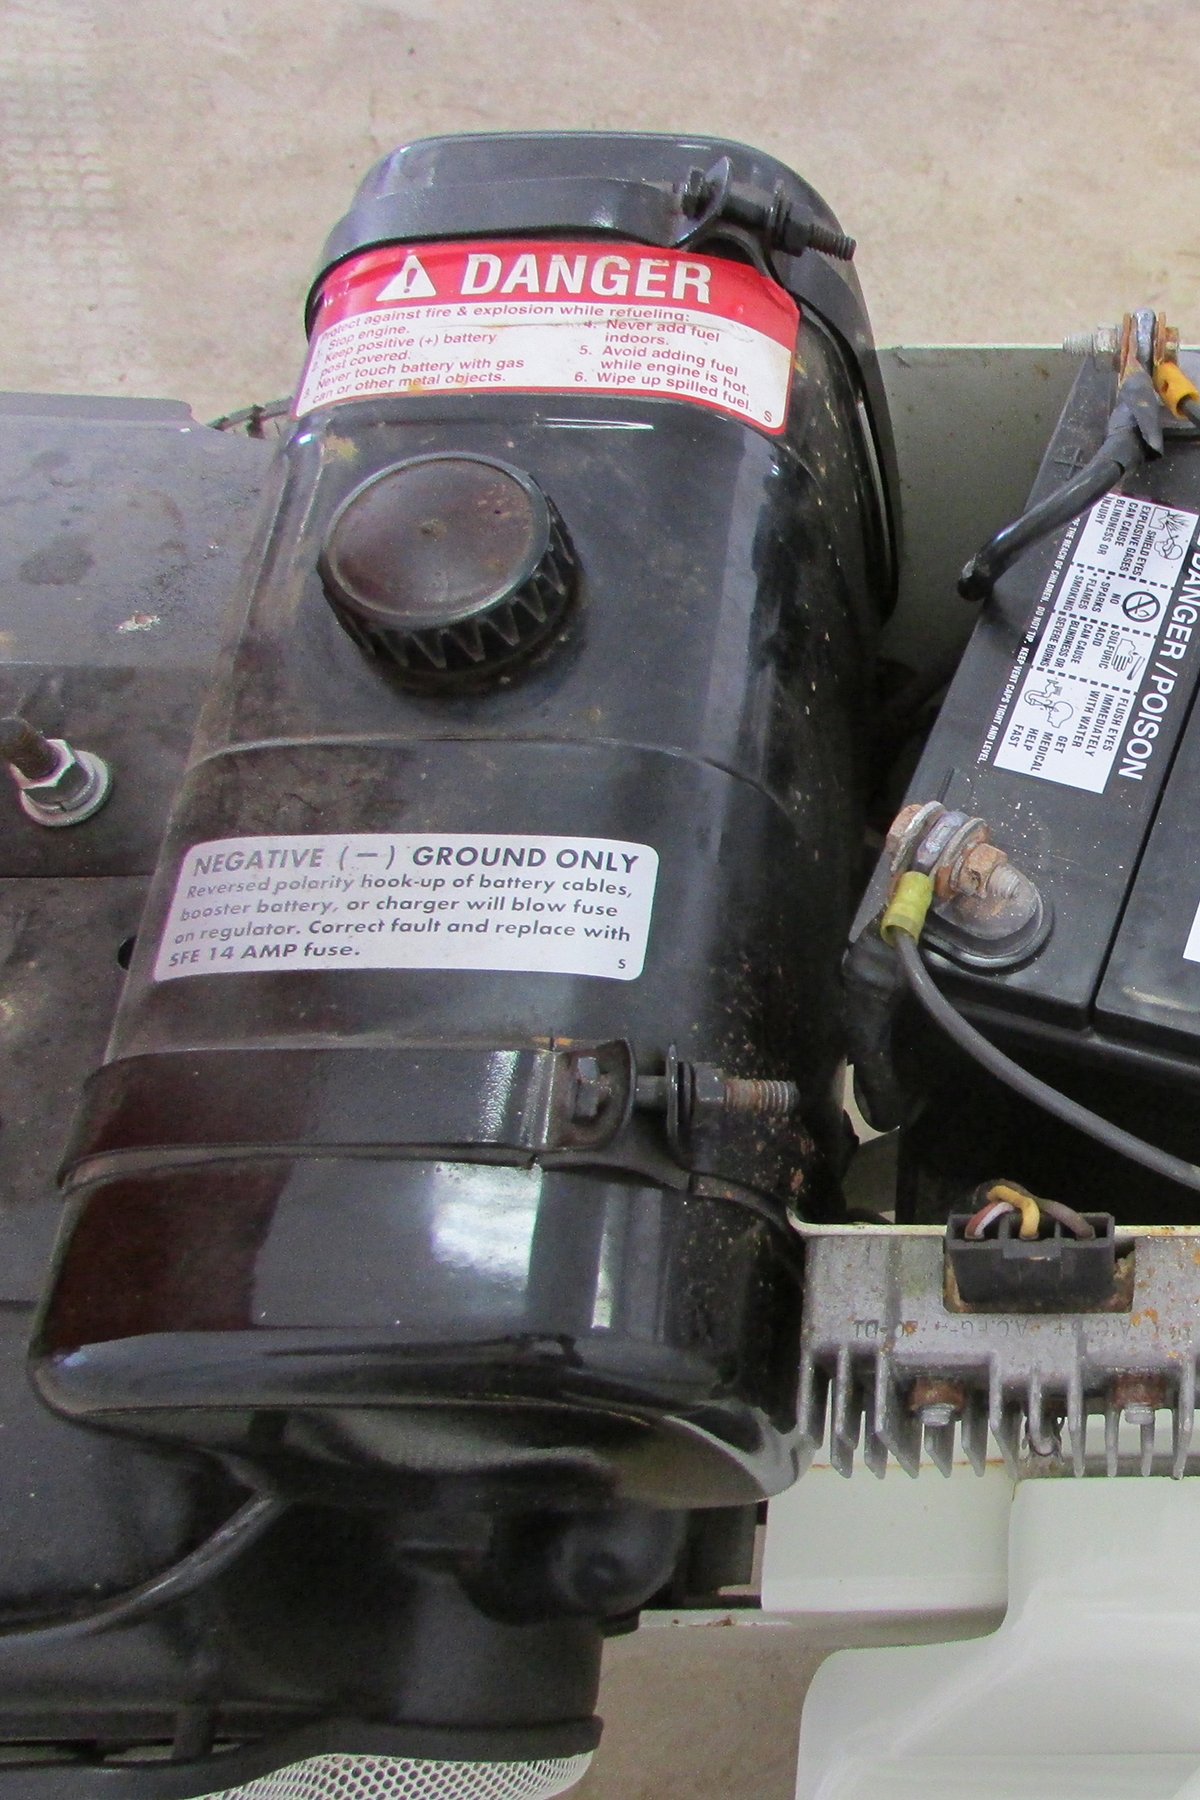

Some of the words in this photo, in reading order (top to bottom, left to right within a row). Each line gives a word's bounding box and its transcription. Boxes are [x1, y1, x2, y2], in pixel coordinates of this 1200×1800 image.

[460, 254, 712, 304] DANGER
[365, 310, 420, 330] against
[426, 307, 451, 318] fire
[457, 306, 467, 316] &
[473, 304, 553, 317] explosion
[560, 304, 604, 316] while
[609, 308, 690, 322] refueling:
[358, 325, 409, 340] engine.
[605, 333, 669, 346] indoors.
[606, 319, 652, 331] Never
[656, 323, 686, 334] add
[691, 325, 720, 342] fuel
[356, 337, 414, 354] positive
[444, 333, 496, 345] battery
[350, 351, 411, 366] covered.
[579, 345, 592, 356] 5.
[602, 346, 647, 357] Avoid
[651, 349, 706, 368] adding
[711, 359, 738, 377] fuel
[316, 373, 349, 392] Never
[355, 364, 395, 379] touch
[401, 360, 454, 374] battery
[459, 359, 491, 370] with
[496, 359, 525, 371] gas
[337, 384, 350, 396] or
[354, 376, 394, 391] other
[399, 372, 440, 386] metal
[445, 372, 506, 385] objects.
[601, 360, 642, 371] while
[647, 364, 700, 379] engine
[705, 371, 718, 383] is
[723, 376, 750, 396] hot.
[574, 372, 587, 382] 6.
[597, 372, 636, 386] Wipe
[641, 376, 661, 388] up
[666, 378, 718, 397] spilled
[722, 391, 752, 412] fuel.
[764, 410, 773, 423] S
[1093, 495, 1113, 525] INJURY
[1101, 498, 1126, 542] BLINDNESS
[1124, 501, 1138, 519] CAN
[1113, 520, 1132, 547] CAUSE
[1128, 504, 1151, 546] EXPLOSIVE
[1096, 543, 1109, 555] OR
[1139, 529, 1156, 556] SHIELD
[1118, 546, 1136, 572] GASES
[1131, 556, 1146, 576] EYES
[1062, 574, 1084, 611] SMOKING
[1077, 578, 1097, 610] FLAMES
[1091, 581, 1110, 612] SPARKS
[1109, 593, 1121, 605] NO
[1048, 616, 1066, 643] SEVERE
[1057, 619, 1079, 657] BLINDNESS
[1079, 622, 1093, 639] CAN
[1091, 626, 1107, 647] ACID
[1014, 646, 1029, 665] KEEP
[1039, 643, 1056, 667] BURNS
[1070, 639, 1087, 664] CAUSE
[1097, 629, 1120, 669] SULFURIC
[1007, 664, 1022, 683] VENT
[1053, 657, 1065, 668] OR
[999, 683, 1015, 703] CAPS
[1083, 689, 1100, 713] WITH
[992, 703, 1007, 724] TIGHT
[1110, 697, 1129, 726] FLUSH
[986, 724, 999, 740] AND
[1007, 724, 1024, 747] FAST
[1070, 715, 1091, 747] WATER
[1083, 693, 1115, 757] IMMEDIATELY
[1021, 727, 1038, 751] HELP
[1029, 731, 1053, 772] MEDICAL
[1052, 734, 1068, 753] GET
[1101, 727, 1118, 751] EYES
[193, 848, 324, 876] NEGATIVE
[412, 846, 547, 867] GROUND
[556, 849, 639, 873] ONLY
[187, 877, 271, 899] Reversed
[273, 875, 354, 895] polarity
[361, 873, 446, 891] hook-up
[453, 873, 474, 888] of
[479, 874, 556, 893] battery
[562, 877, 633, 898] cables,
[180, 904, 250, 922] booster
[256, 899, 339, 921] battery,
[347, 899, 370, 910] or
[376, 896, 460, 914] charger
[467, 897, 506, 911] will
[511, 897, 566, 913] blow
[573, 899, 618, 917] fuse
[174, 932, 194, 945] on
[200, 922, 301, 942] regulator.
[308, 919, 385, 935] Correct
[391, 918, 441, 933] fault
[447, 918, 489, 933] and
[496, 920, 576, 938] replace
[584, 926, 631, 943] with
[168, 949, 200, 967] SFE
[209, 945, 235, 960] 14
[240, 943, 297, 959] AMP
[304, 942, 360, 957] fuse.
